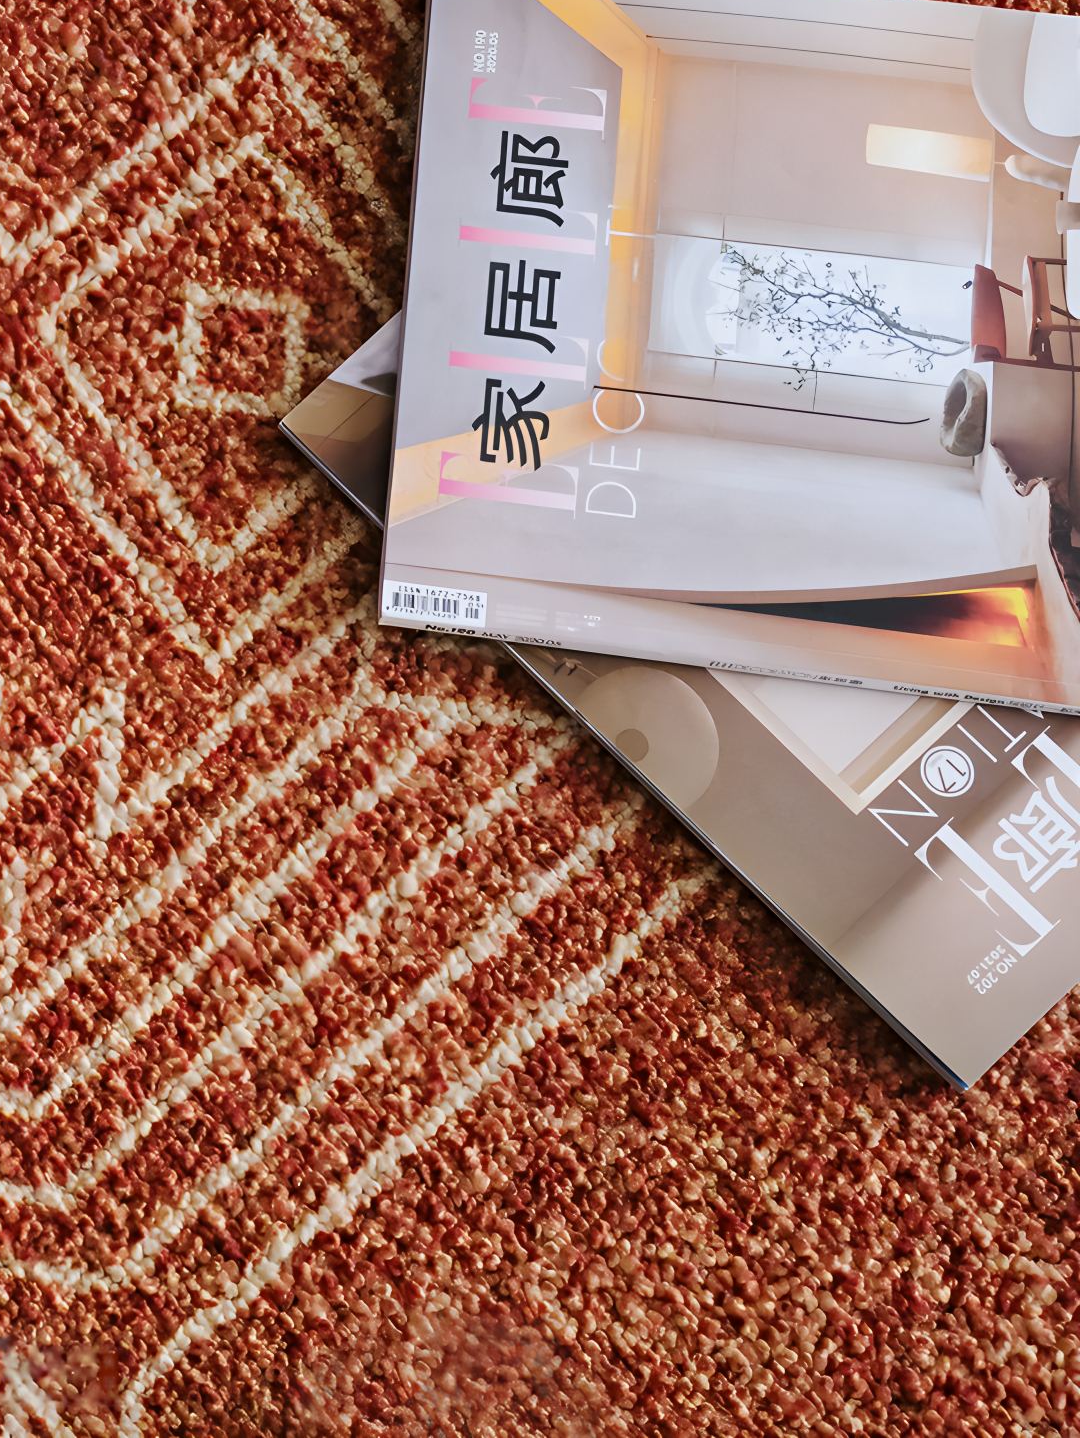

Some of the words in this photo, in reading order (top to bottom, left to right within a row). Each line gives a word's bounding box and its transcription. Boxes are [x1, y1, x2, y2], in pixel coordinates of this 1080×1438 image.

[472, 130, 569, 472] 家居廊
[974, 952, 1018, 995] NO.202
